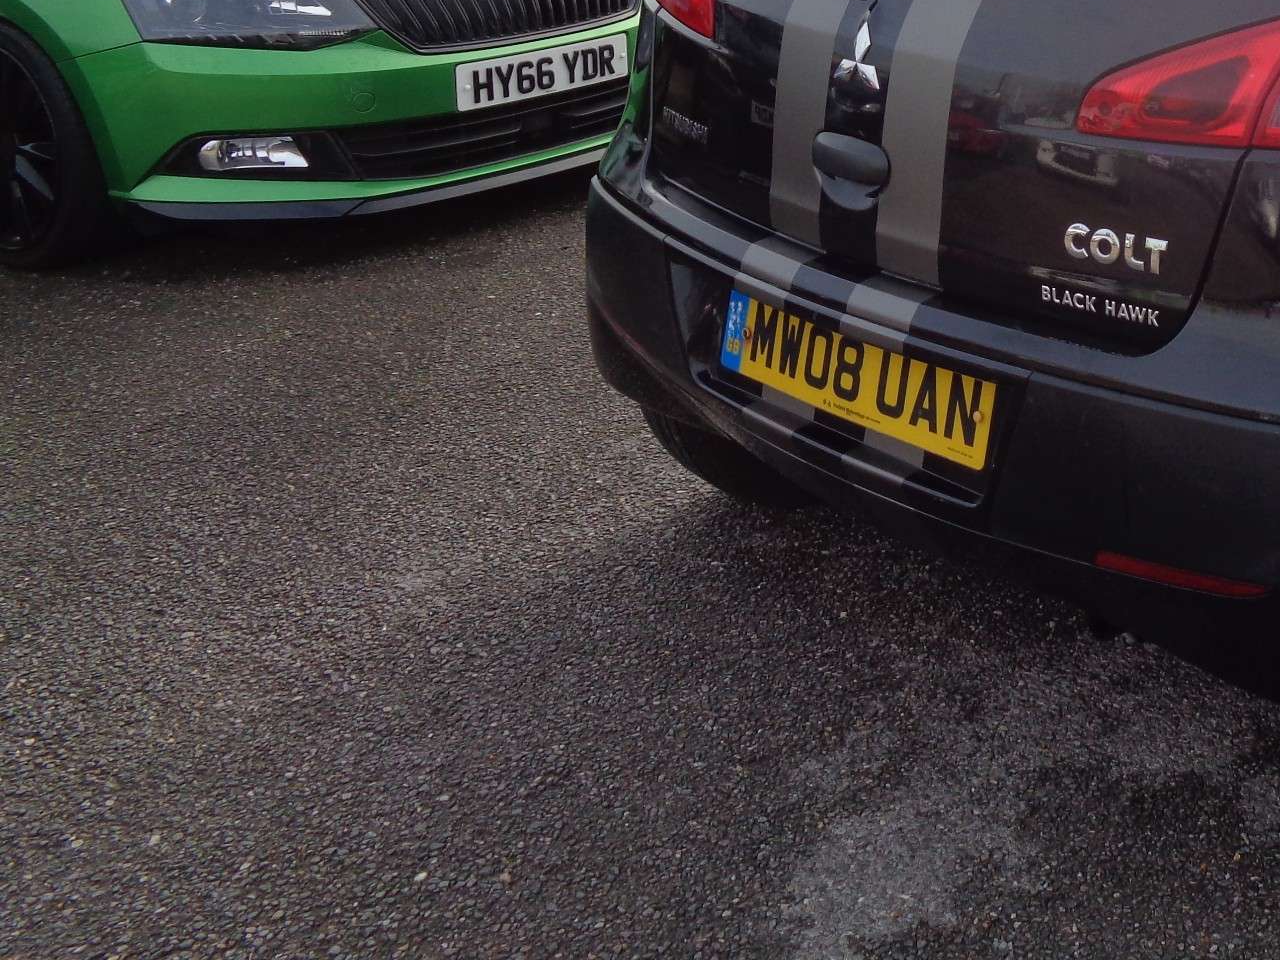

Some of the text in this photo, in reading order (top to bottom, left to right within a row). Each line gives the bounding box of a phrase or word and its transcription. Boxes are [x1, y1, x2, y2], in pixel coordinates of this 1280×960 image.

[472, 44, 615, 104] HY66 YDR
[1064, 223, 1168, 275] COLT
[1041, 285, 1159, 327] BLACK HAWK
[750, 302, 983, 448] MW08 UAN
